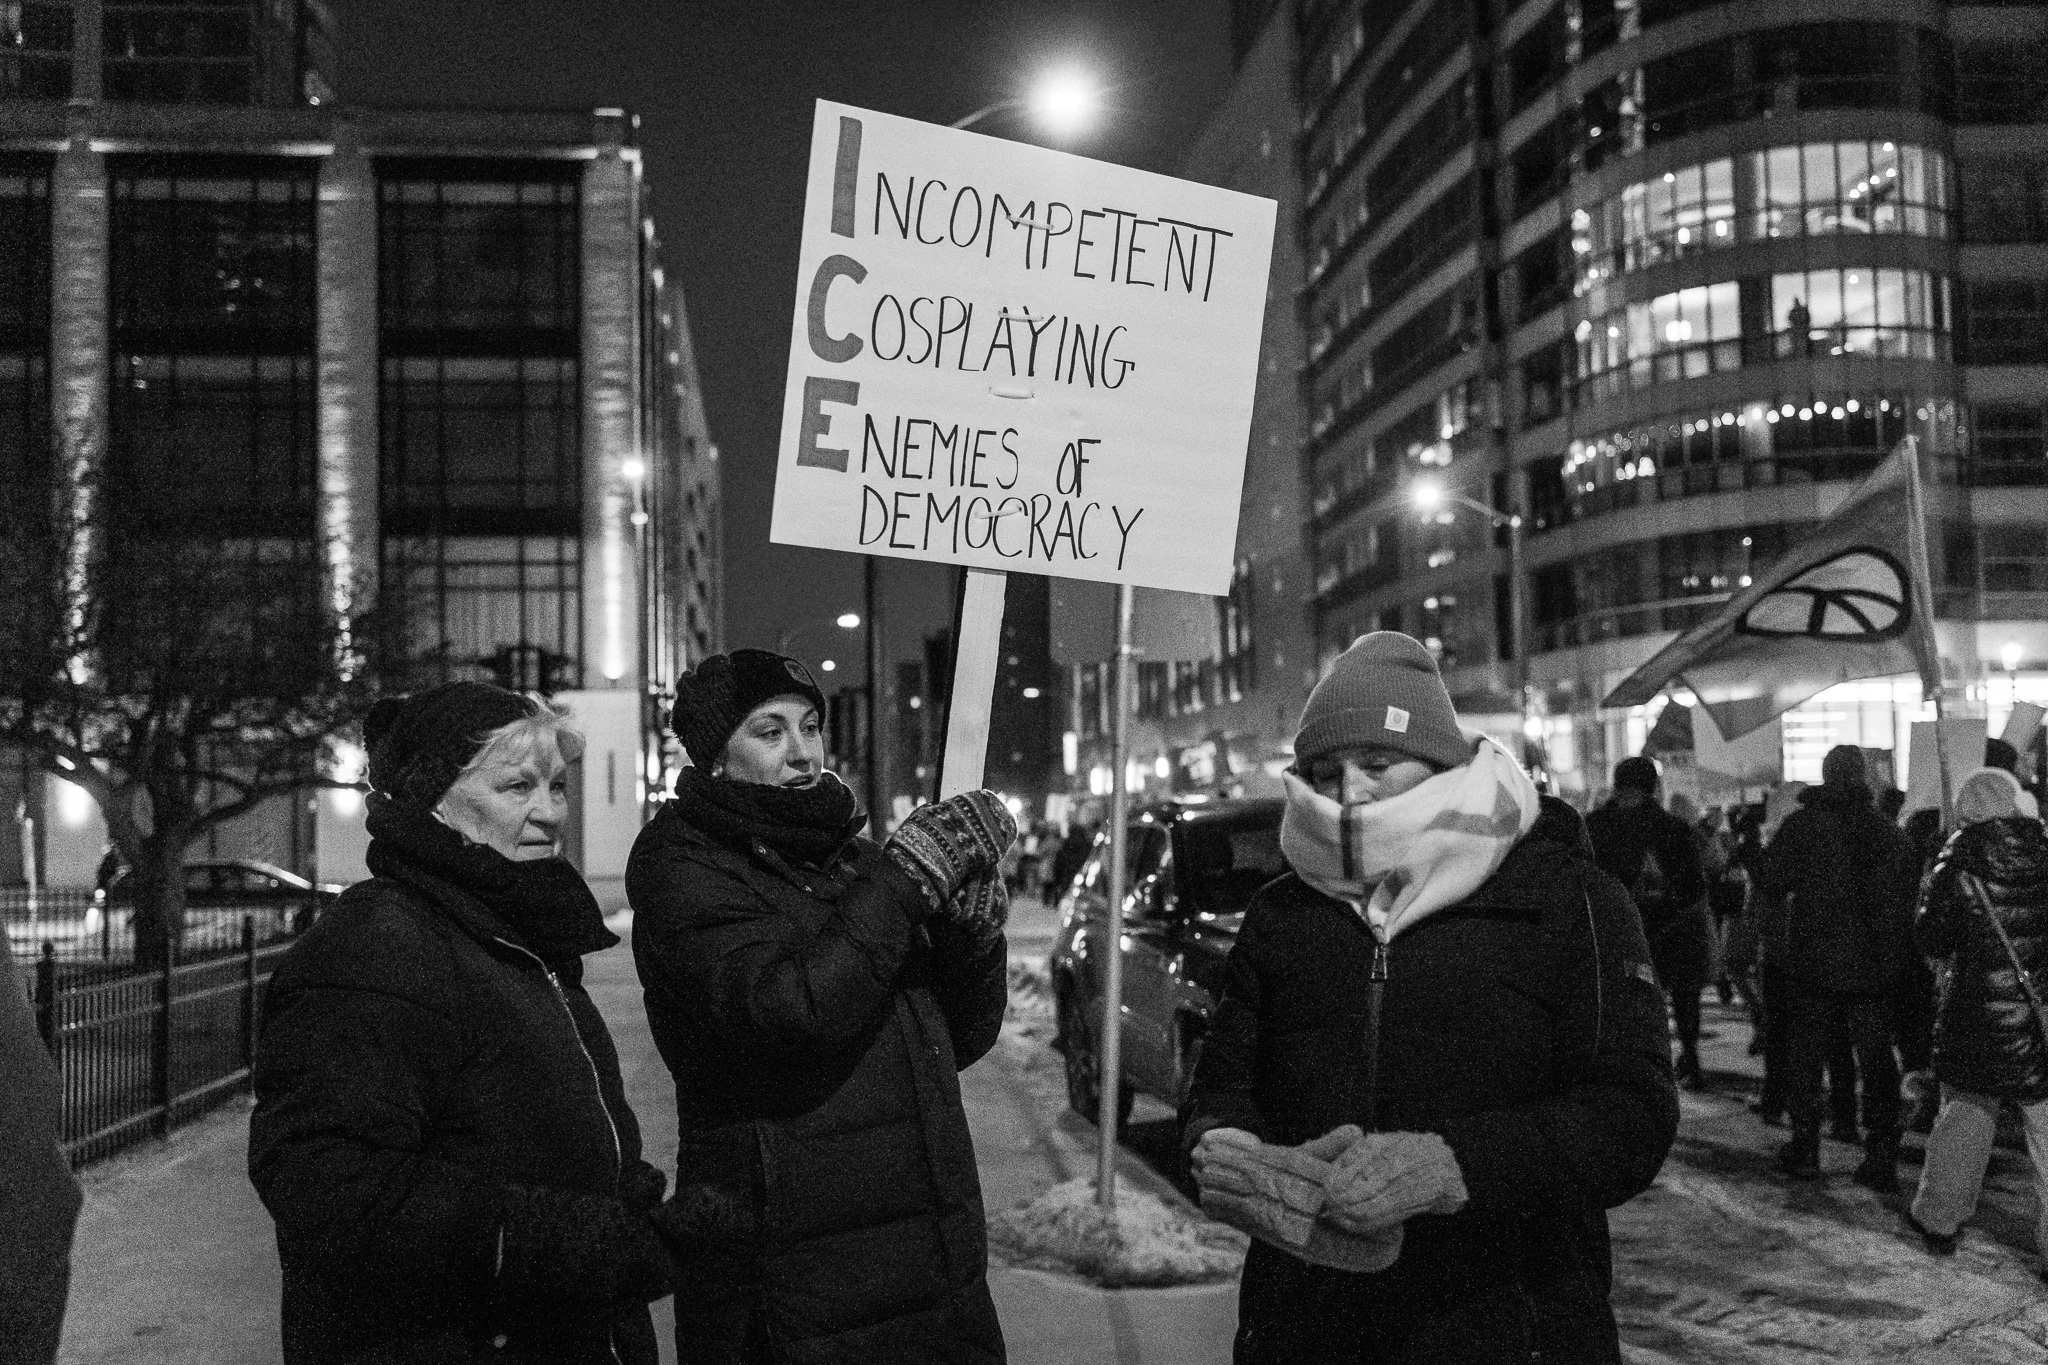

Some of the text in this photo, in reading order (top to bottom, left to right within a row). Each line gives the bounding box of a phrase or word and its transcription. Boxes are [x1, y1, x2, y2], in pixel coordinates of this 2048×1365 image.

[831, 116, 1233, 302] INCOMPETENT
[807, 254, 1135, 389] COSPLAYING
[797, 376, 1101, 497] ENEMIES OF
[859, 484, 1144, 570] DEMOCRACY
